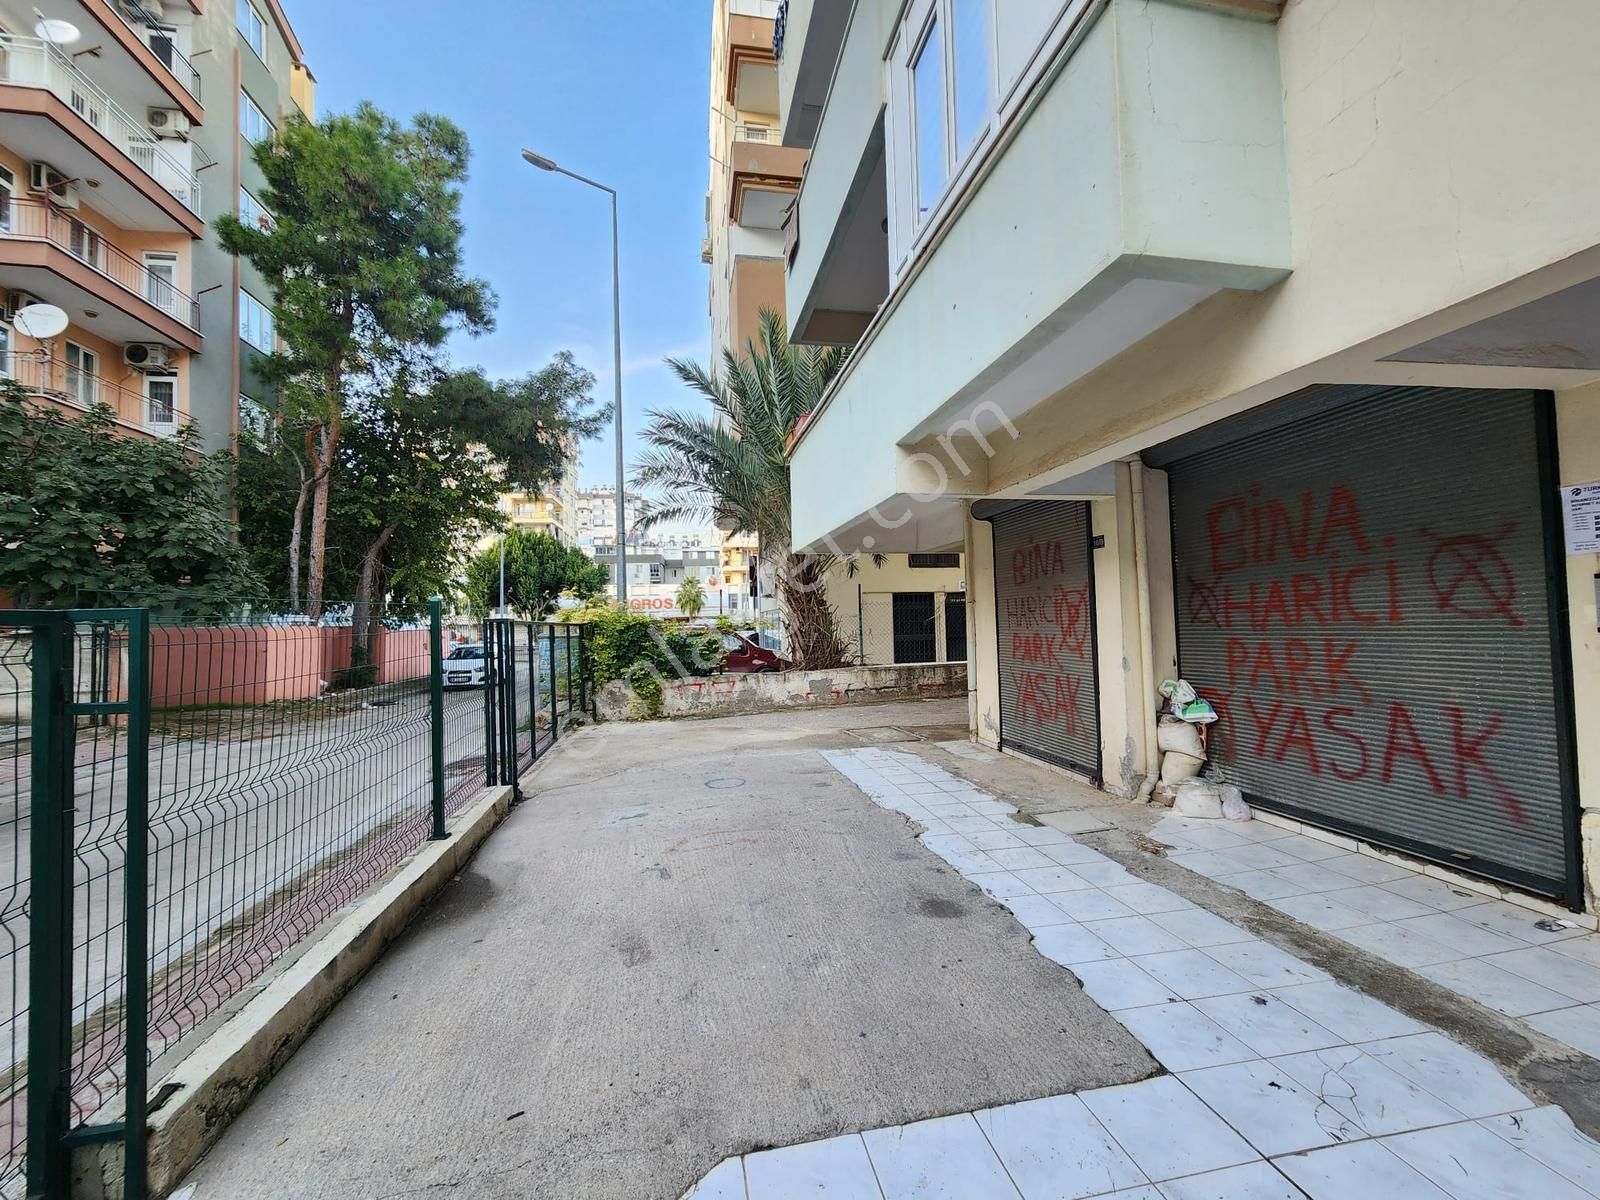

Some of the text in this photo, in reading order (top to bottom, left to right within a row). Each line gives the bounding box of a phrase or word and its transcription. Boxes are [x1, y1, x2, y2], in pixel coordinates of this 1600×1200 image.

[1011, 632, 1063, 673] PARK
[1222, 638, 1374, 706] PARK
[1012, 667, 1090, 741] YASAK
[1243, 698, 1526, 825] YASAK
